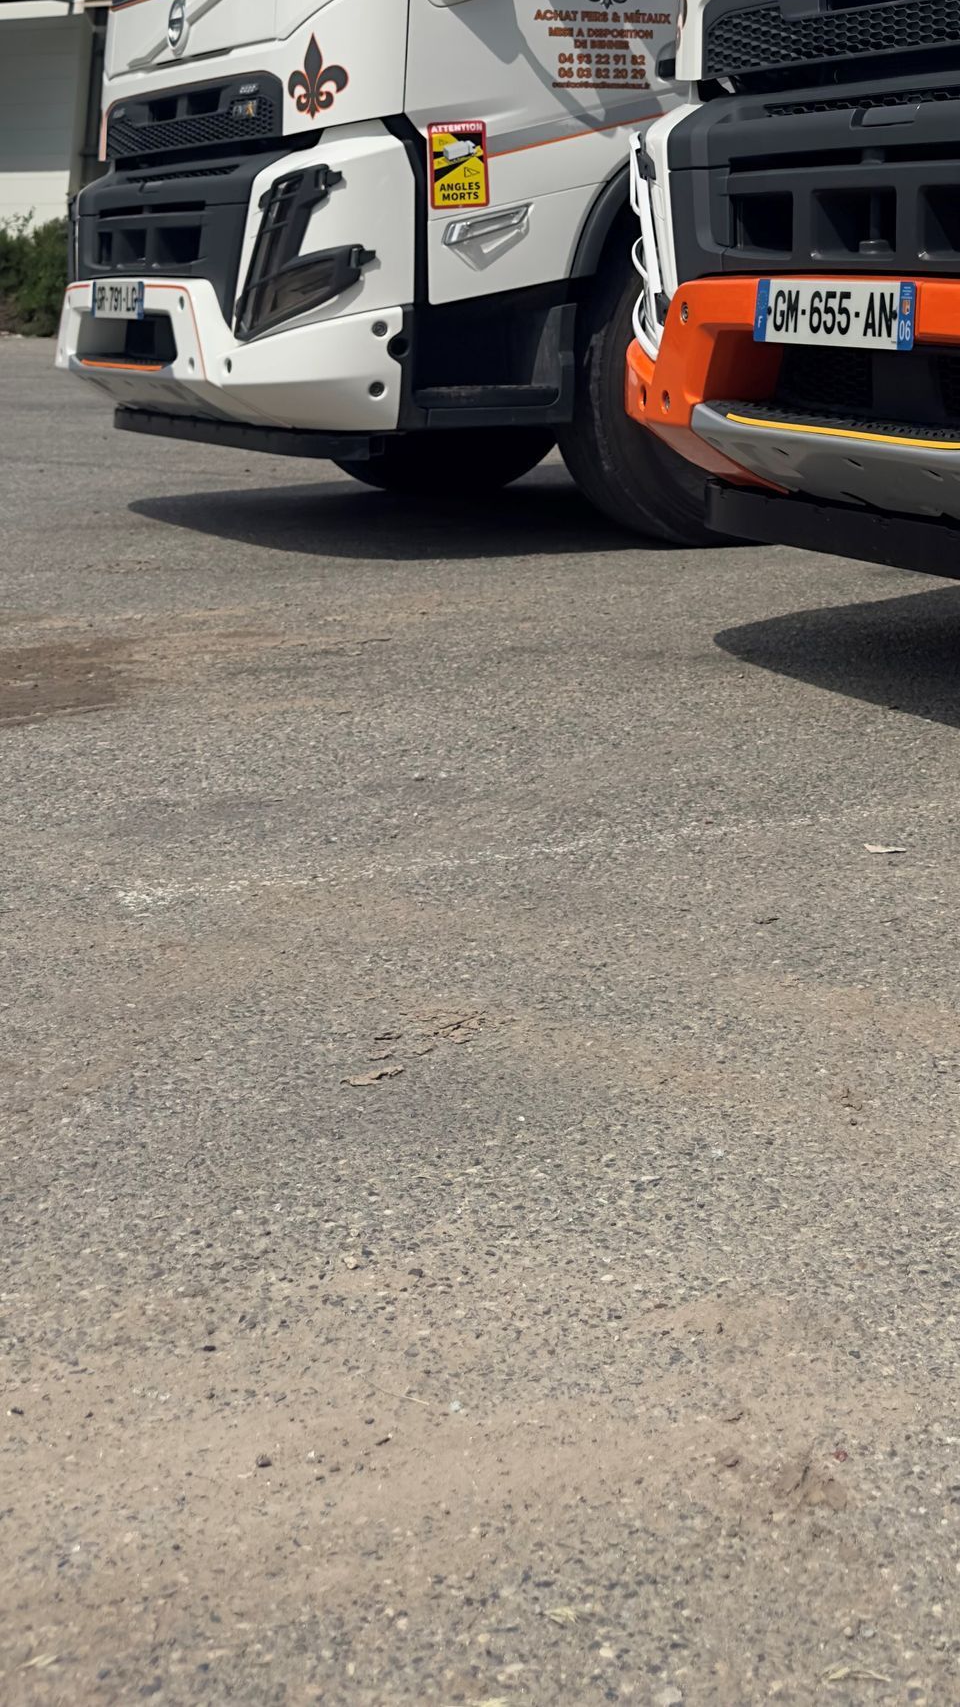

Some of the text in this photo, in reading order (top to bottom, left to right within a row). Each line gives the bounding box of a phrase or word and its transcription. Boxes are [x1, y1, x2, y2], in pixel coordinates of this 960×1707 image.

[534, 9, 578, 22] ACHAT
[623, 9, 671, 25] MÉTAUX
[558, 53, 646, 65] 04 93 22 91 82
[558, 67, 574, 78] 06
[595, 68, 610, 78] 82
[613, 68, 629, 78] 20
[631, 68, 646, 79] 29
[431, 123, 483, 133] ATTENTION
[440, 182, 480, 192] ANGLES
[442, 191, 479, 201] MORTS
[898, 320, 912, 341] 06
